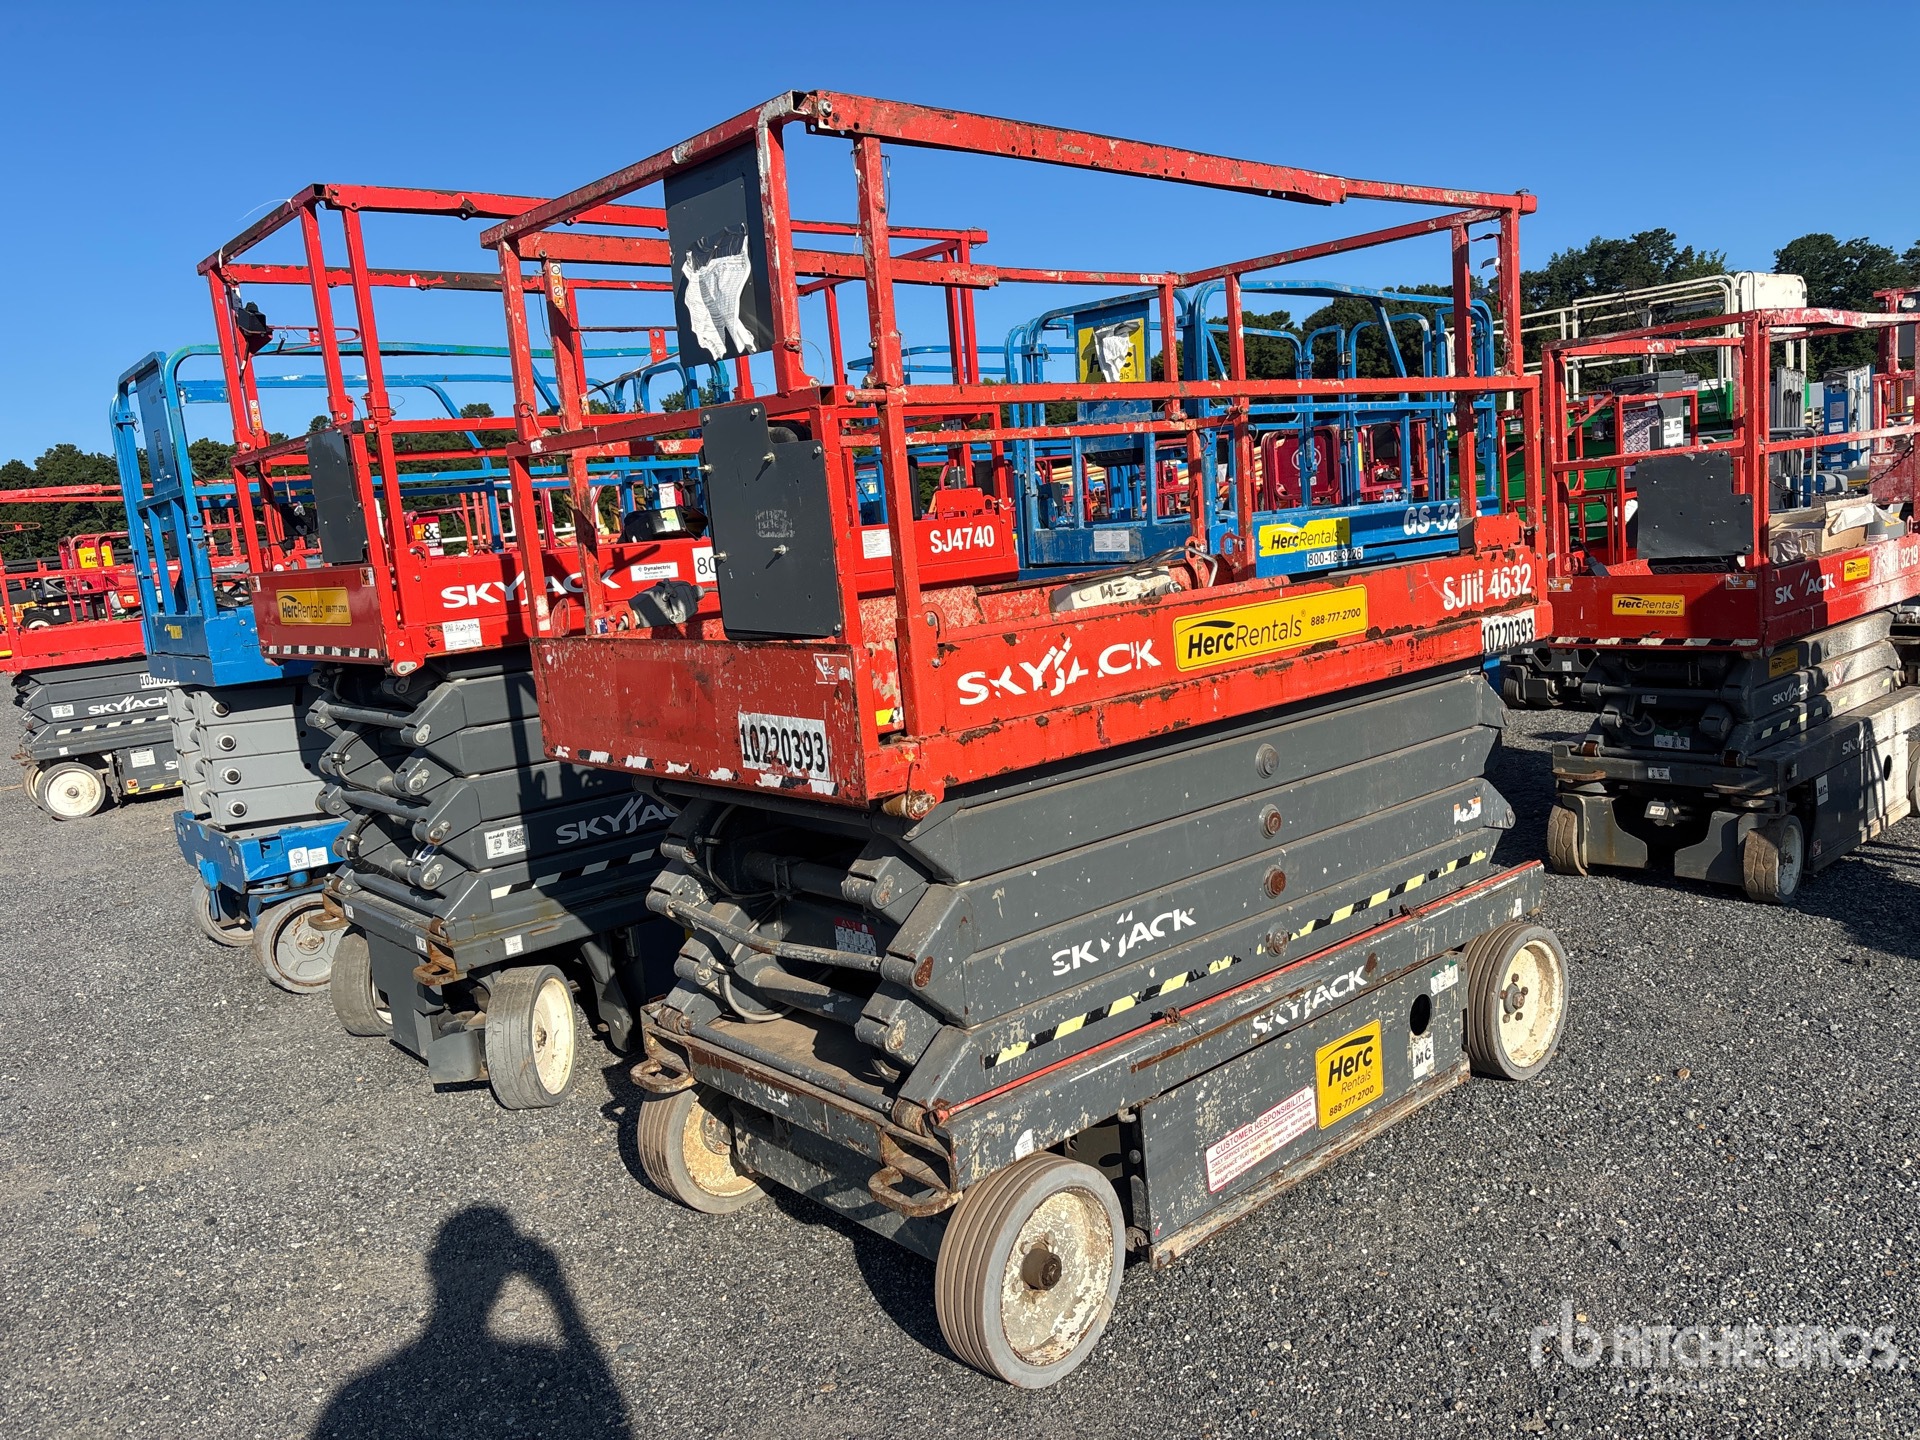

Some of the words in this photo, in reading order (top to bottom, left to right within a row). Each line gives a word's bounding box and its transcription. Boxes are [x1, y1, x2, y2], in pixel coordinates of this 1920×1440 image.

[1403, 501, 1482, 535] GS-32
[929, 525, 994, 553] SJ4740
[1308, 547, 1362, 565] 800-18-3226
[1900, 544, 1919, 569] 3219
[1486, 563, 1532, 600] 4632
[1310, 608, 1361, 626] 888-777-2700
[1482, 617, 1534, 654] 10220393
[88, 695, 168, 715] SKYJACK
[740, 723, 826, 773] 10220393
[556, 795, 681, 844] SKYJAC
[1328, 1046, 1374, 1088] Herc
[1341, 1070, 1372, 1095] Rentals
[1329, 1085, 1375, 1117] 888-777-2700
[1215, 1125, 1253, 1155] CUSTOMER
[1254, 1092, 1306, 1130] RESPONSIBILITY
